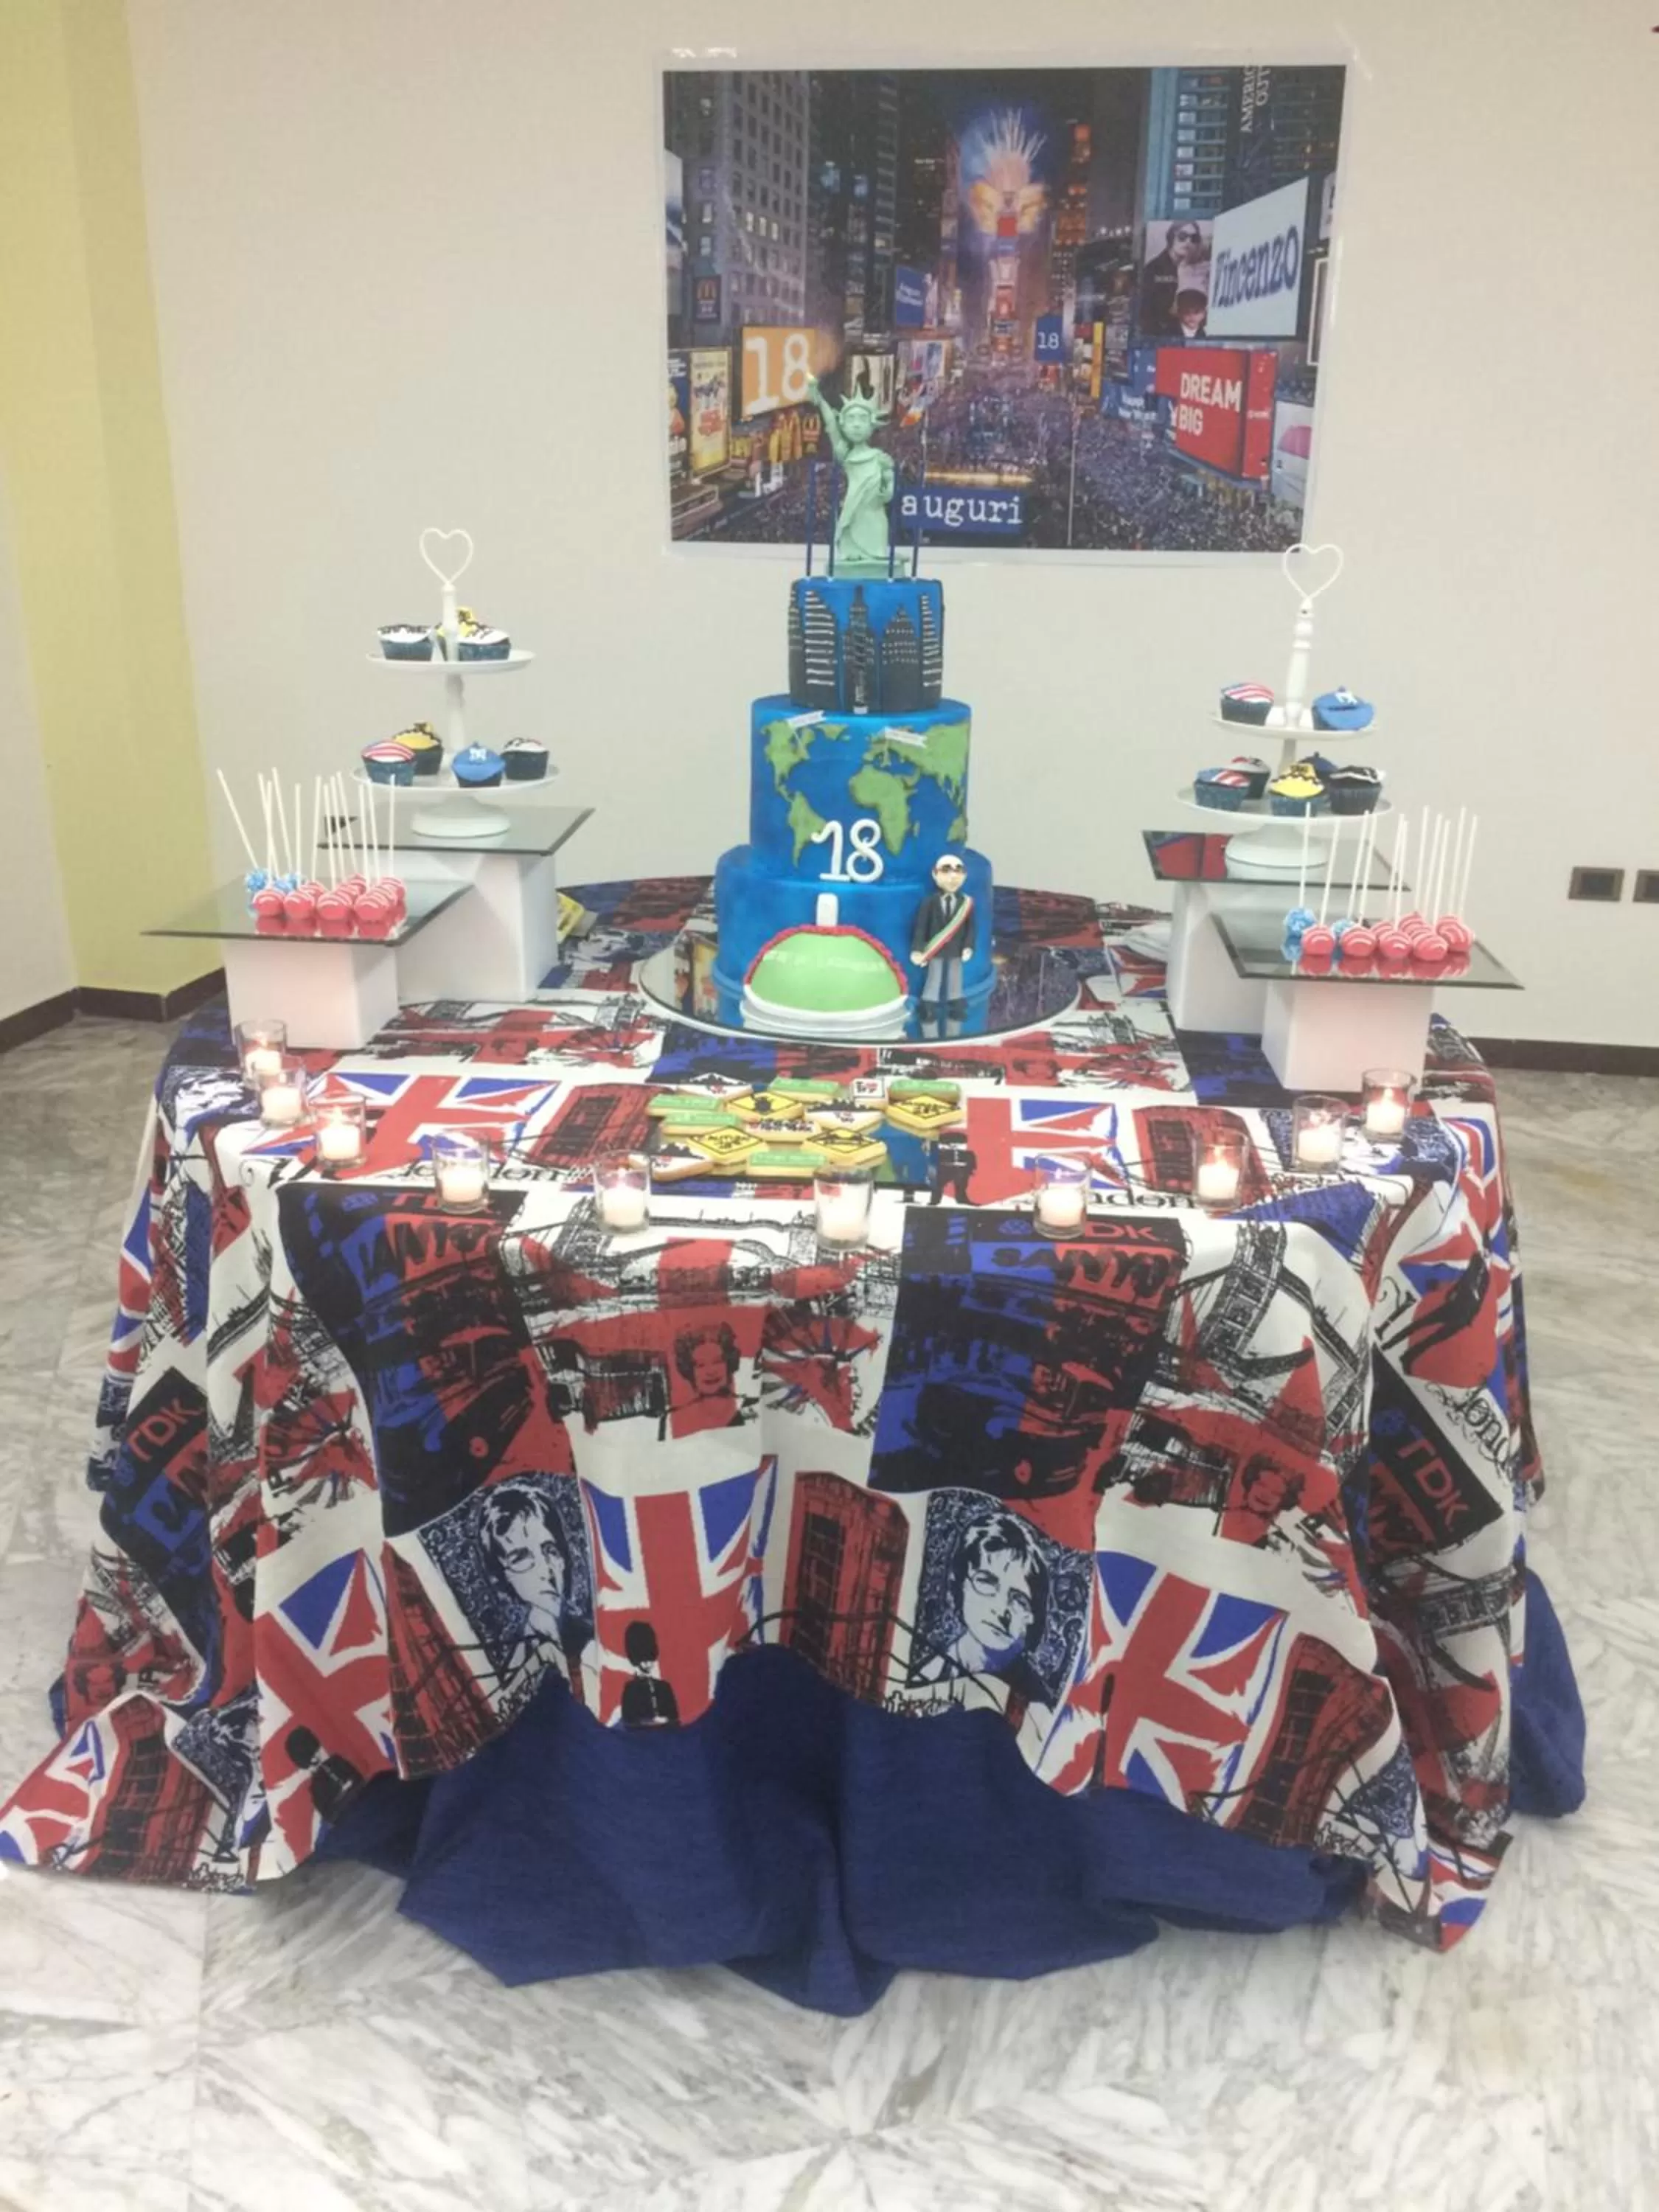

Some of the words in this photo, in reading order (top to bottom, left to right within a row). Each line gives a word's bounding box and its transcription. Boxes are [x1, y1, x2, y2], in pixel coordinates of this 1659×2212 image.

[1037, 332, 1060, 350] 18
[744, 333, 810, 416] 18
[1180, 372, 1242, 414] DREAM
[1178, 403, 1204, 437] BIG
[900, 494, 1023, 528] auguri
[810, 818, 884, 883] 18
[1084, 1223, 1161, 1242] DK
